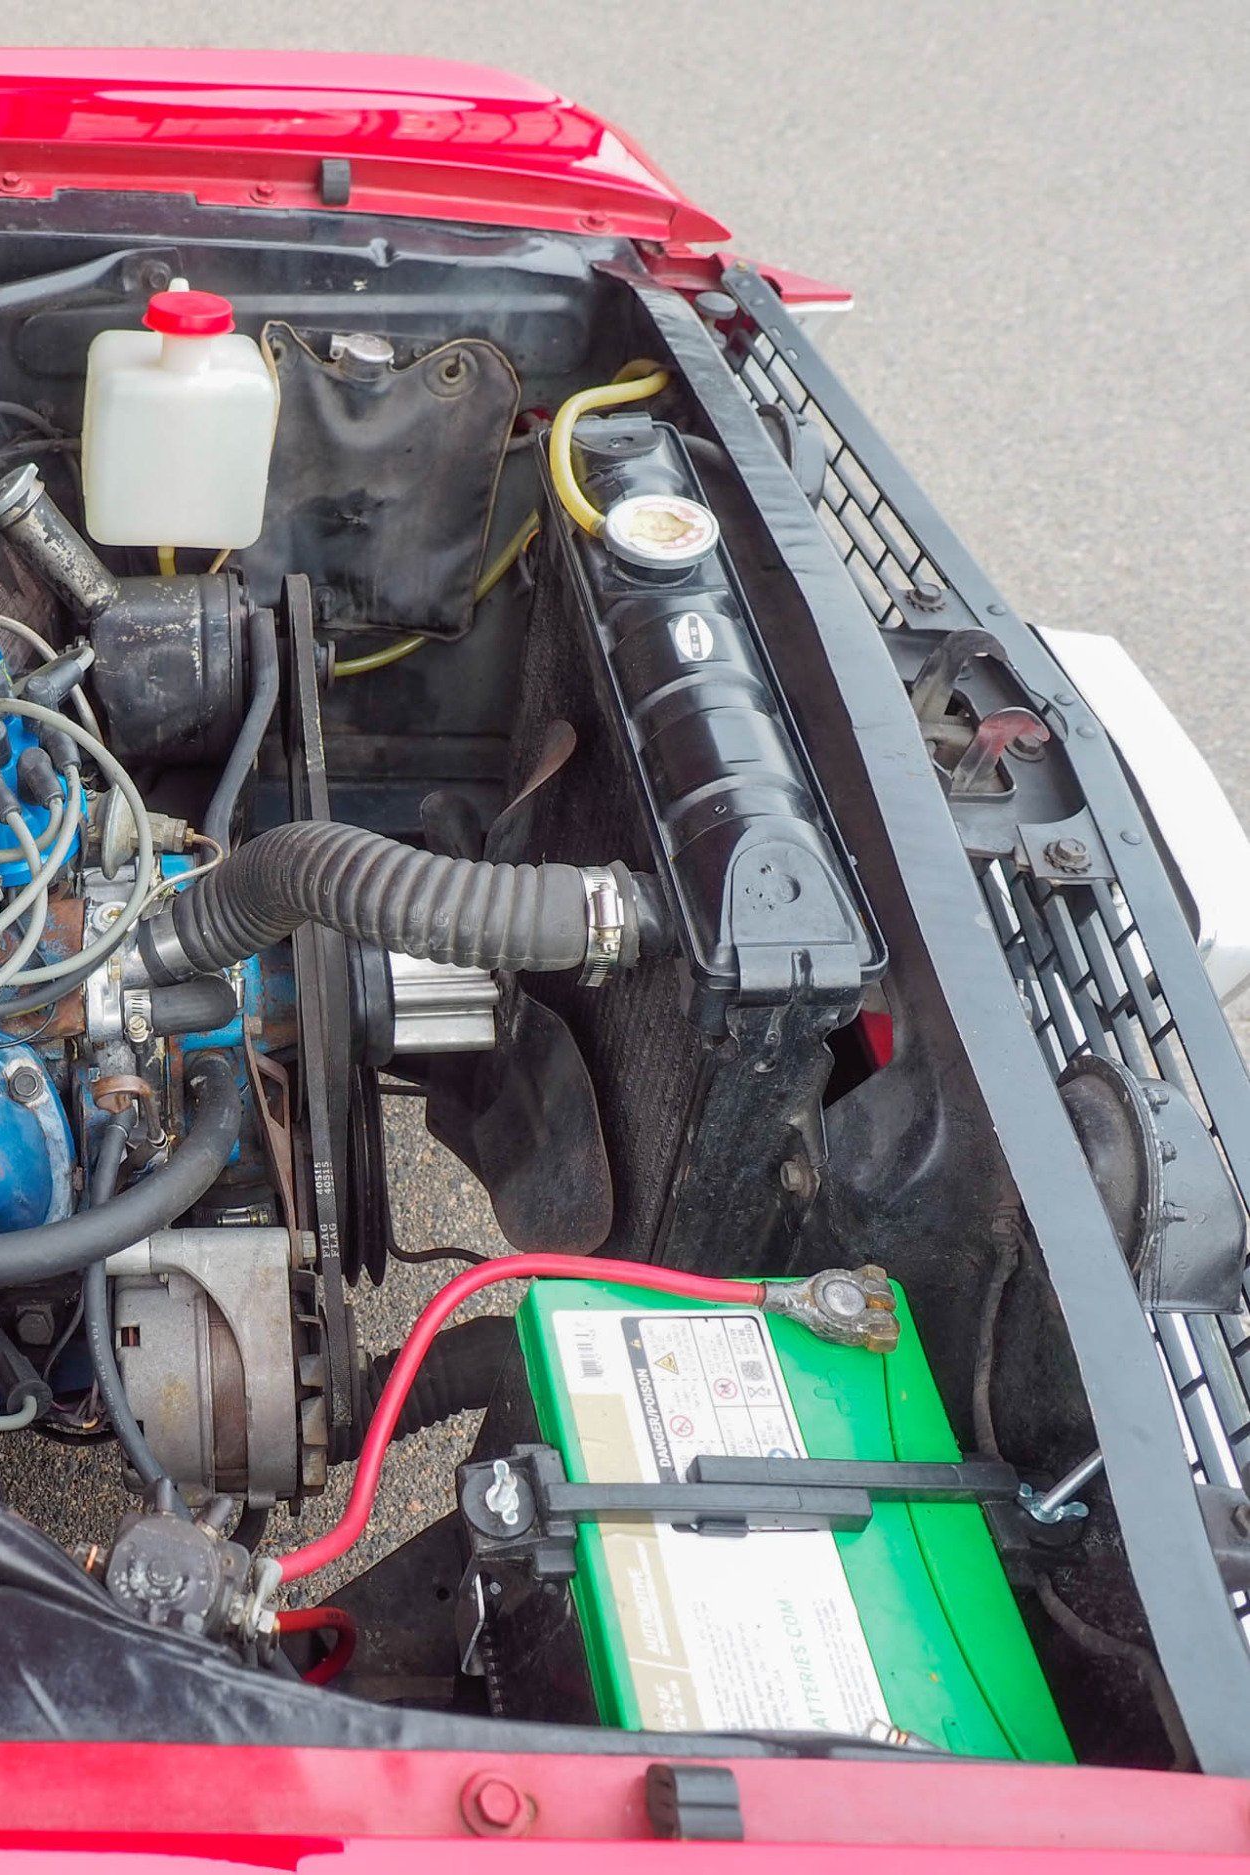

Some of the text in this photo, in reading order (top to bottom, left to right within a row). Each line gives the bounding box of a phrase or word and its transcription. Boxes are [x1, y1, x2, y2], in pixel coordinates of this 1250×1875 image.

[314, 1162, 331, 1259] FLAG 40515
[322, 1161, 340, 1258] FLAG 40515
[635, 1368, 671, 1467] DANGER/POISON
